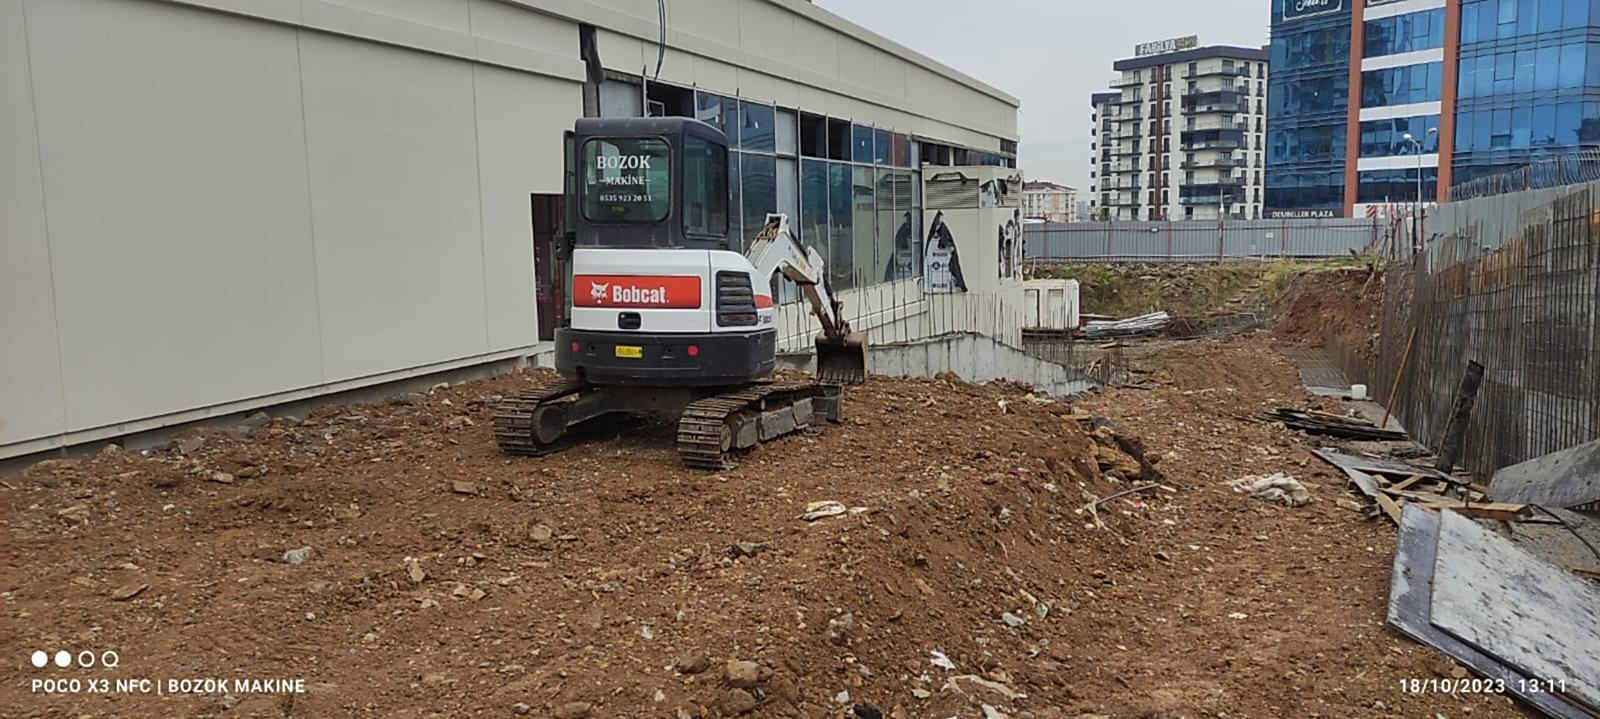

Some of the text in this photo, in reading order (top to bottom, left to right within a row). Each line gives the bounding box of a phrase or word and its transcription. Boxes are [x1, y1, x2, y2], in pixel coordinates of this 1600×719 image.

[596, 154, 651, 169] BOZOK
[1310, 210, 1334, 218] PLAZA
[612, 285, 666, 303] Bobcat
